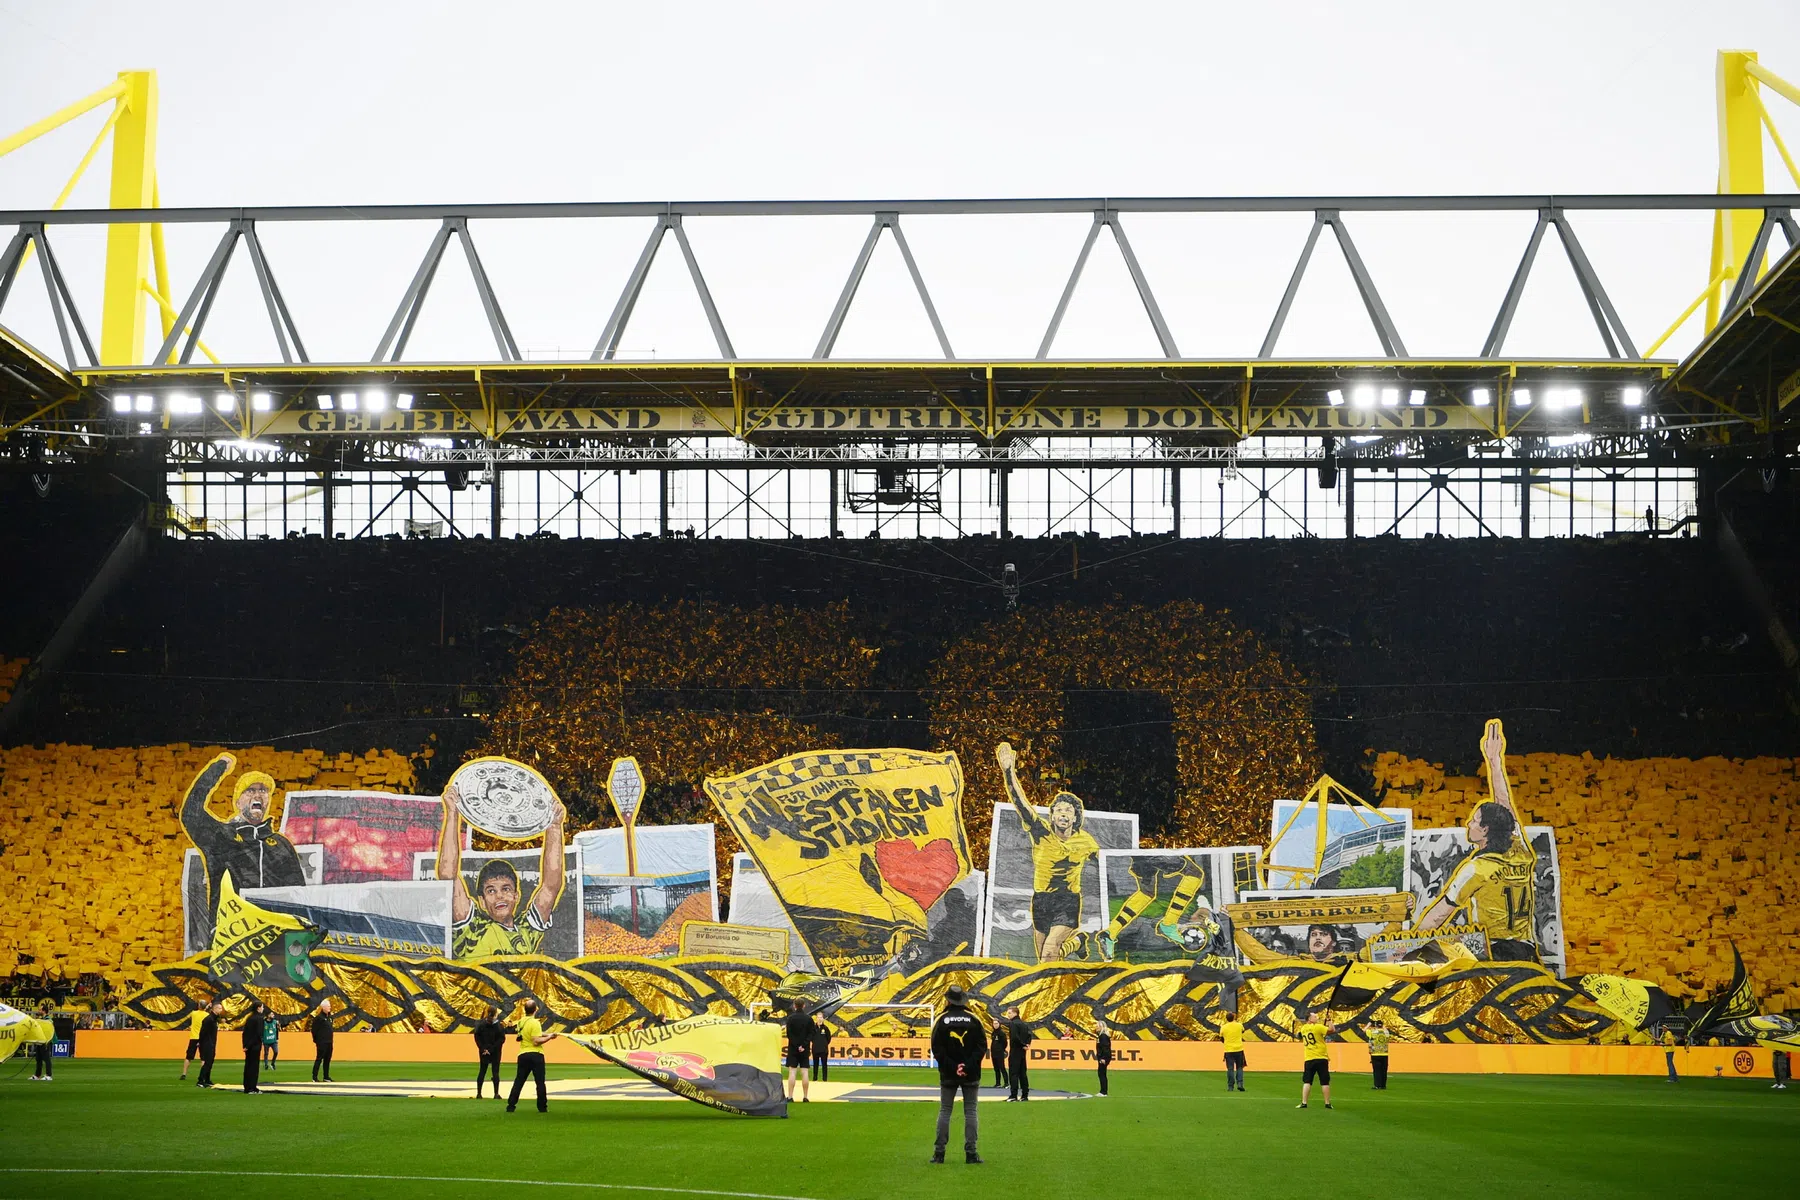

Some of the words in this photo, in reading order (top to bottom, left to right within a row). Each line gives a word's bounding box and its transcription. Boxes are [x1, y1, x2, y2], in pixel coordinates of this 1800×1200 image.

[298, 410, 471, 432] GELBE
[504, 408, 661, 431] WAND
[1124, 406, 1448, 429] DORTMUND
[811, 778, 859, 797] IMMER
[738, 784, 944, 841] WESTFALEN
[792, 815, 930, 859] STADION
[1255, 907, 1325, 920] SUPER
[1328, 905, 1378, 917] B.V.B.
[1501, 885, 1531, 931] 14
[323, 932, 443, 955] ALENSTADION
[1595, 981, 1610, 995] BVB
[54, 1043, 68, 1053] 1&1
[1302, 1032, 1317, 1047] 09
[781, 1044, 922, 1059] SHÖNSTE
[1030, 1049, 1075, 1061] DER
[1737, 1053, 1752, 1067] BVB
